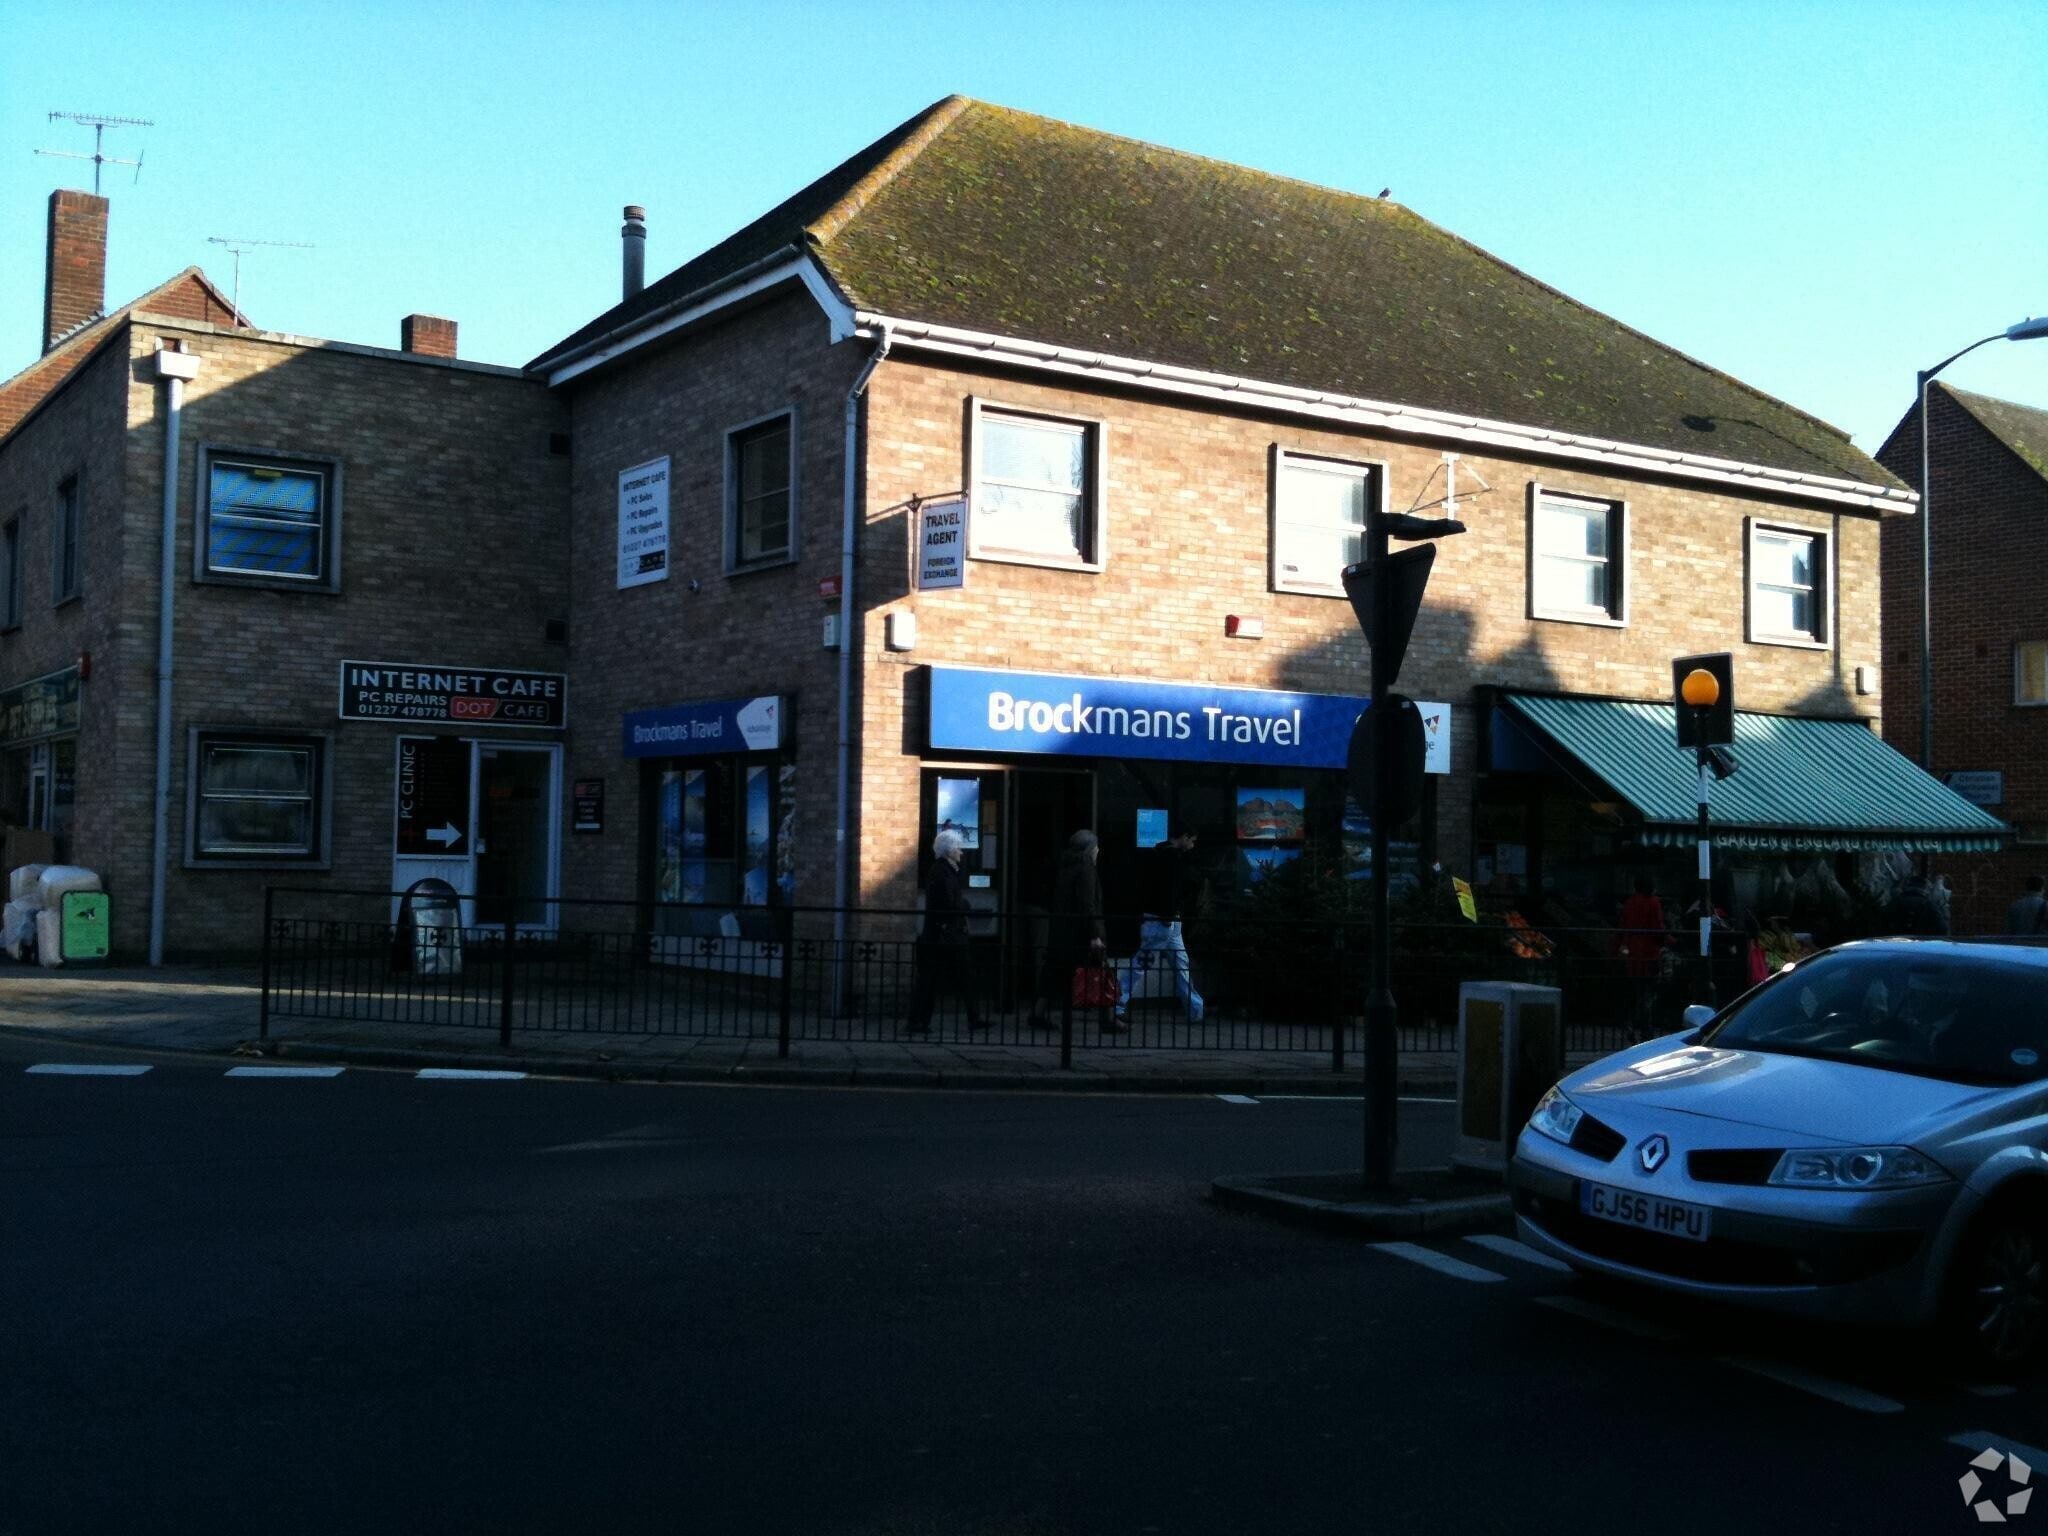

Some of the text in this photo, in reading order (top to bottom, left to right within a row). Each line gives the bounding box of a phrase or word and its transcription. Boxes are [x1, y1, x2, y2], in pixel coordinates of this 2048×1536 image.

[623, 470, 666, 492] INTERNET CAFE
[630, 495, 638, 505] PC
[630, 510, 638, 520] PC
[925, 512, 960, 528] TRAVEL
[630, 526, 638, 535] PC
[926, 530, 958, 546] AGENT
[927, 556, 955, 567] FOREIGN
[924, 567, 958, 579] EXCHANGE
[351, 668, 558, 698] INTERNET CAFE
[358, 690, 448, 706] PC REPAIRS
[358, 703, 448, 719] 01227 478778
[456, 701, 545, 719] DOT CAFE
[988, 691, 1301, 746] Brockmans Travel
[633, 714, 723, 744] Brockmans Travel
[400, 744, 417, 819] PC CLINIC
[1715, 832, 1778, 851] GARDEN
[1795, 834, 1860, 852] ENGLAND
[1592, 1188, 1703, 1236] GJ56 HPU
